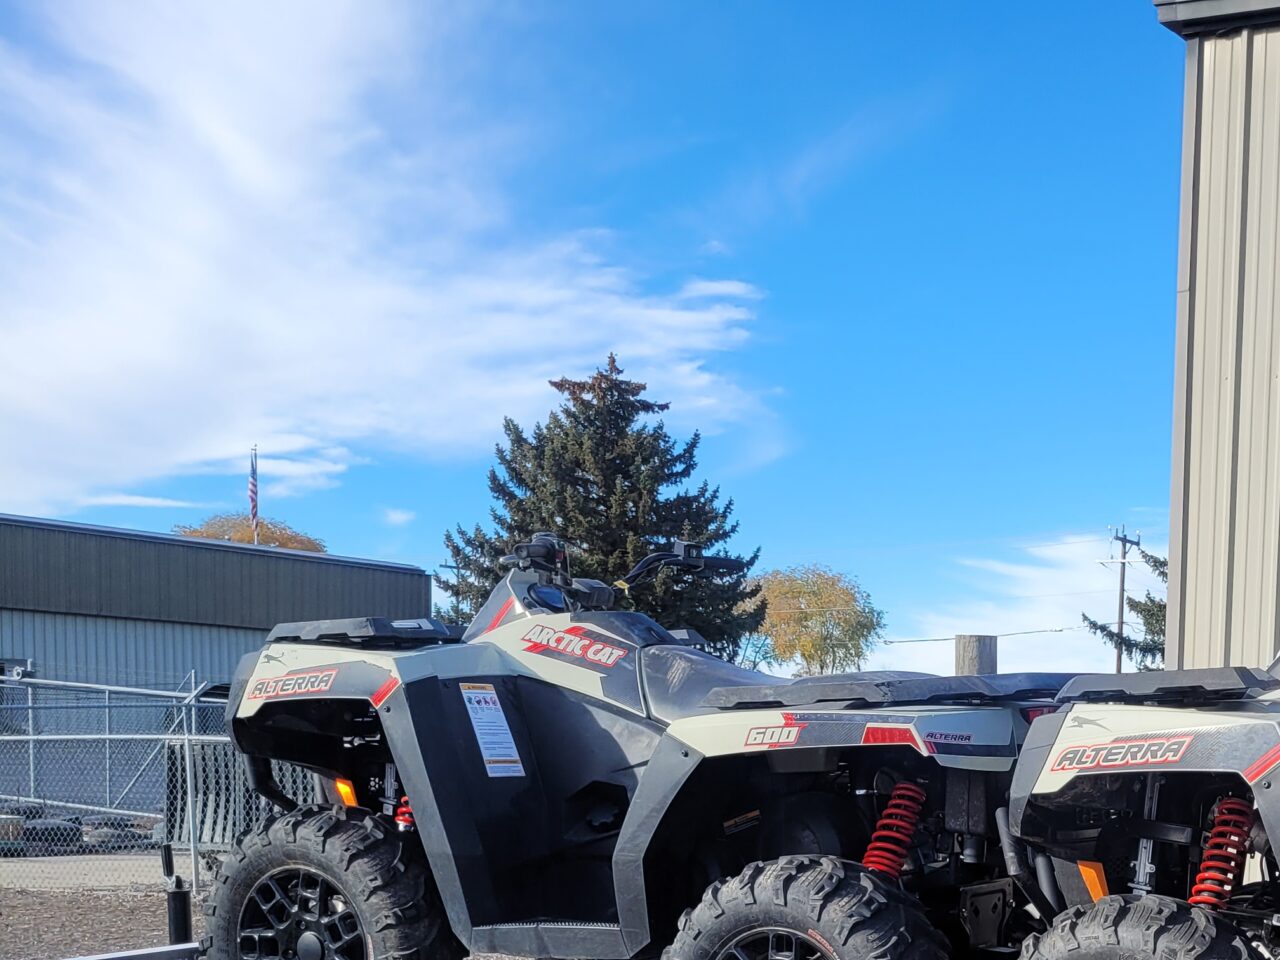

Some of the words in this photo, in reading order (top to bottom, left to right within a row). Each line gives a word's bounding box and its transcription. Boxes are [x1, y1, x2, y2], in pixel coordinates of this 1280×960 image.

[523, 624, 592, 657] ARCTIC
[586, 641, 625, 665] CAT
[251, 672, 335, 697] ALTERRA
[745, 727, 800, 745] 600
[925, 732, 972, 742] ALTERRA
[1054, 738, 1190, 769] ALTERRA
